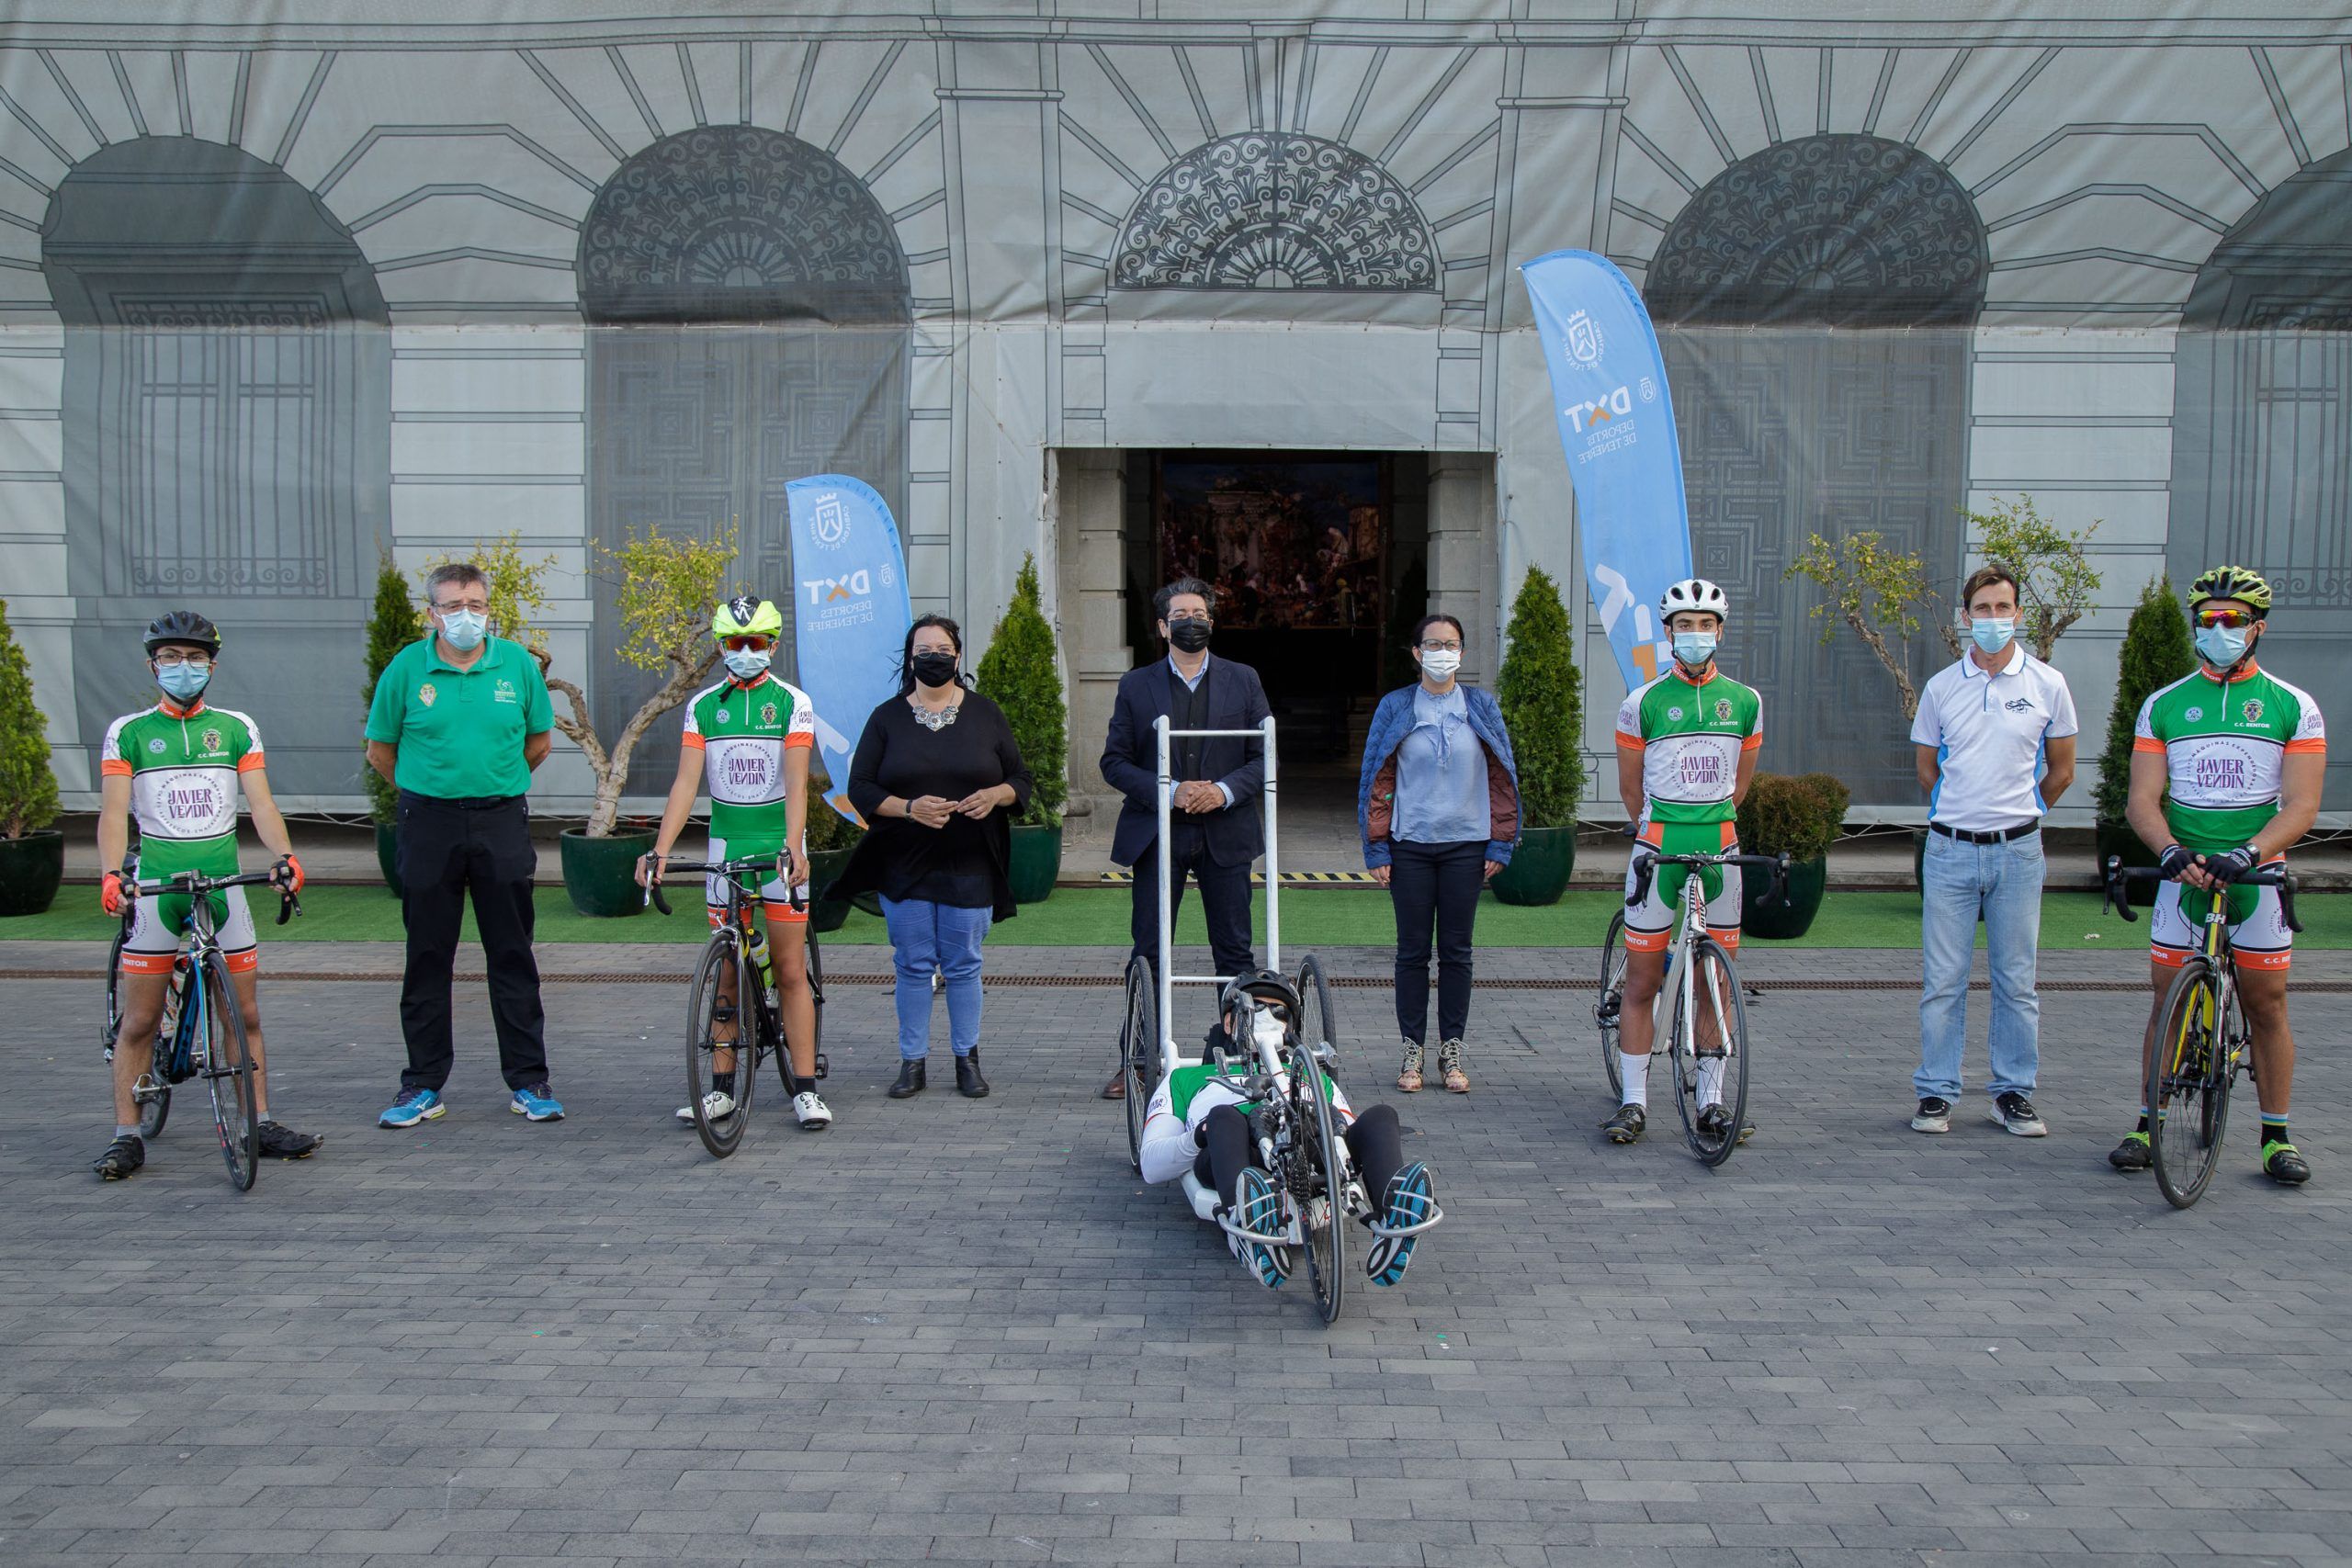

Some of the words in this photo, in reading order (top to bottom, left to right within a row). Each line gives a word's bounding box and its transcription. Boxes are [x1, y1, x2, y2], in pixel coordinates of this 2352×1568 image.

[729, 758, 764, 772] JAVIER
[1680, 756, 1719, 770] JAVIER
[2197, 759, 2245, 774] JAVIER
[729, 773, 765, 784] VENDIN
[1680, 770, 1720, 784] VENDIN
[2197, 773, 2245, 788] VENDIN
[168, 788, 212, 805] JAVIER
[168, 804, 213, 818] VENDIN
[2205, 912, 2226, 924] BH
